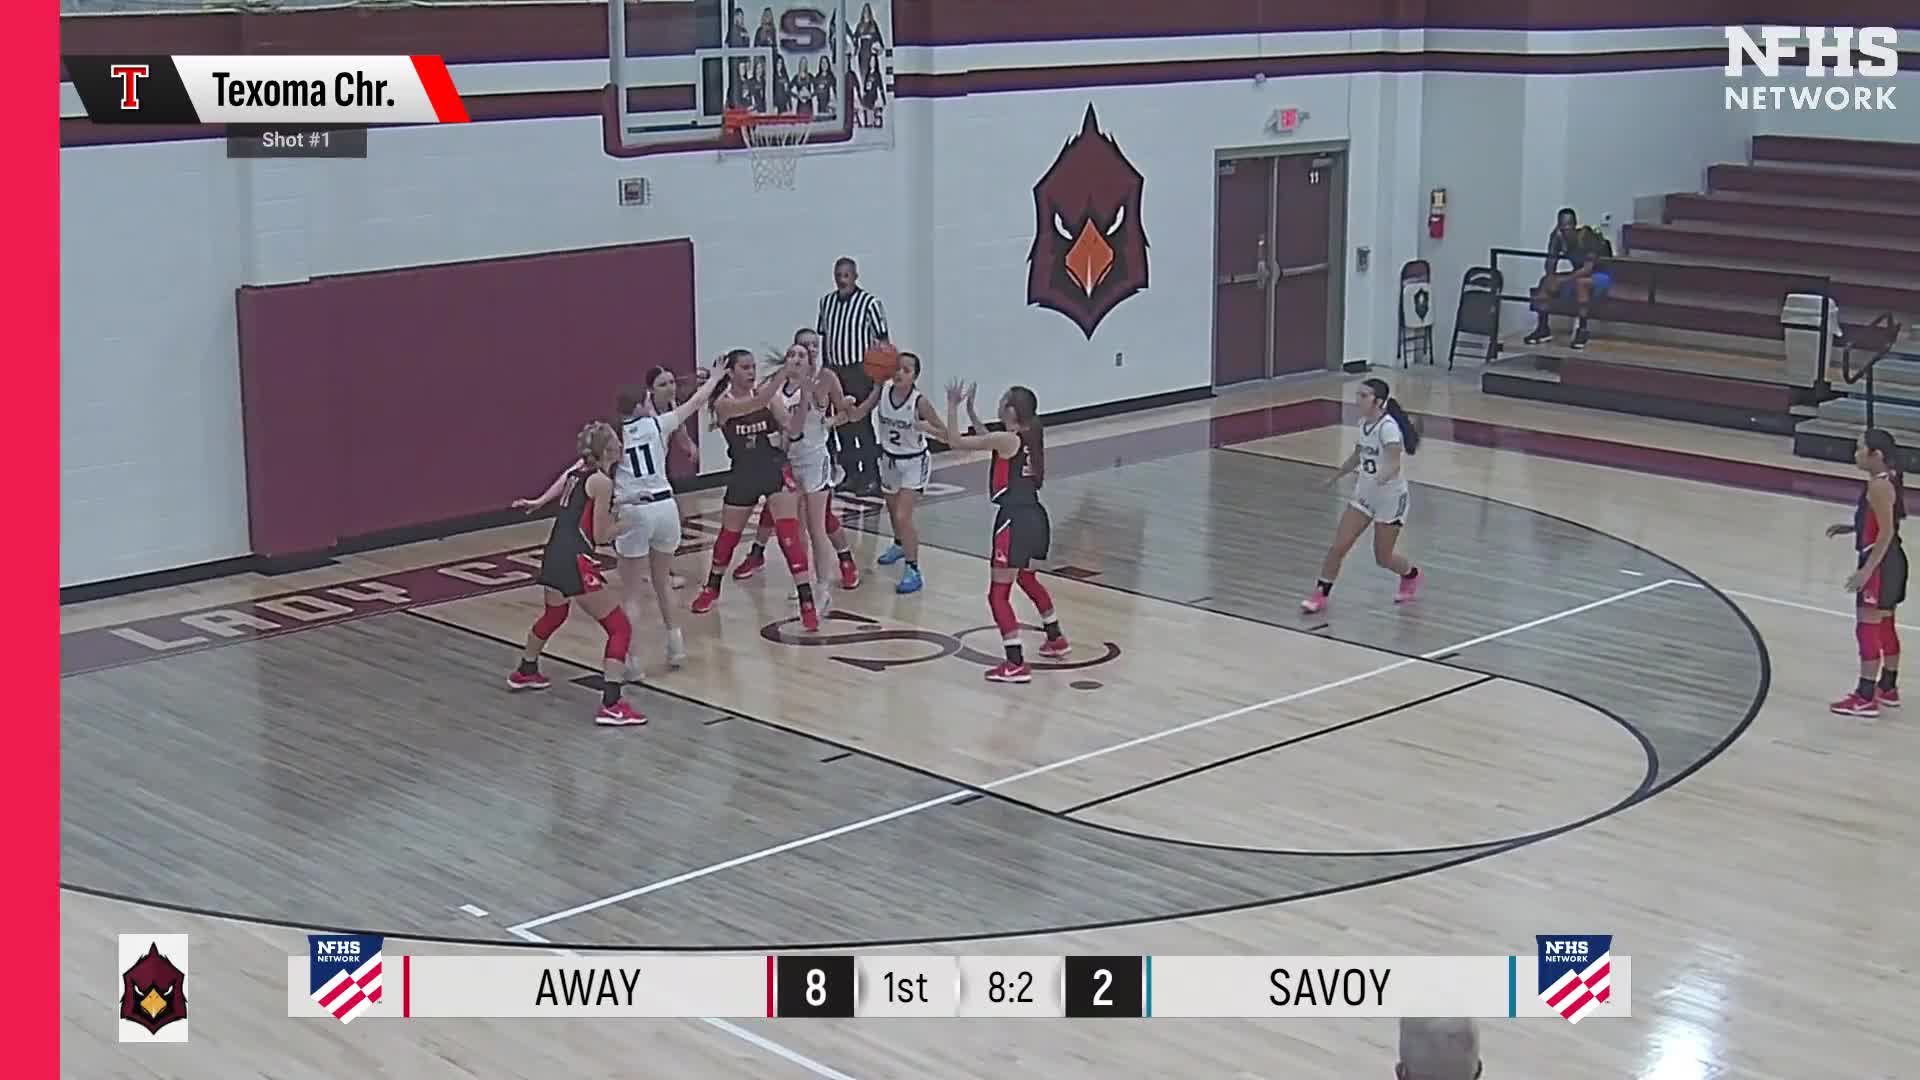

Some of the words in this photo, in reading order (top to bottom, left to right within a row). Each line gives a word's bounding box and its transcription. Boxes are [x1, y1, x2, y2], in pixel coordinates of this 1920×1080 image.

[780, 8, 827, 53] S
[889, 430, 901, 447] 2
[625, 443, 656, 478] 11
[109, 580, 411, 652] LADY
